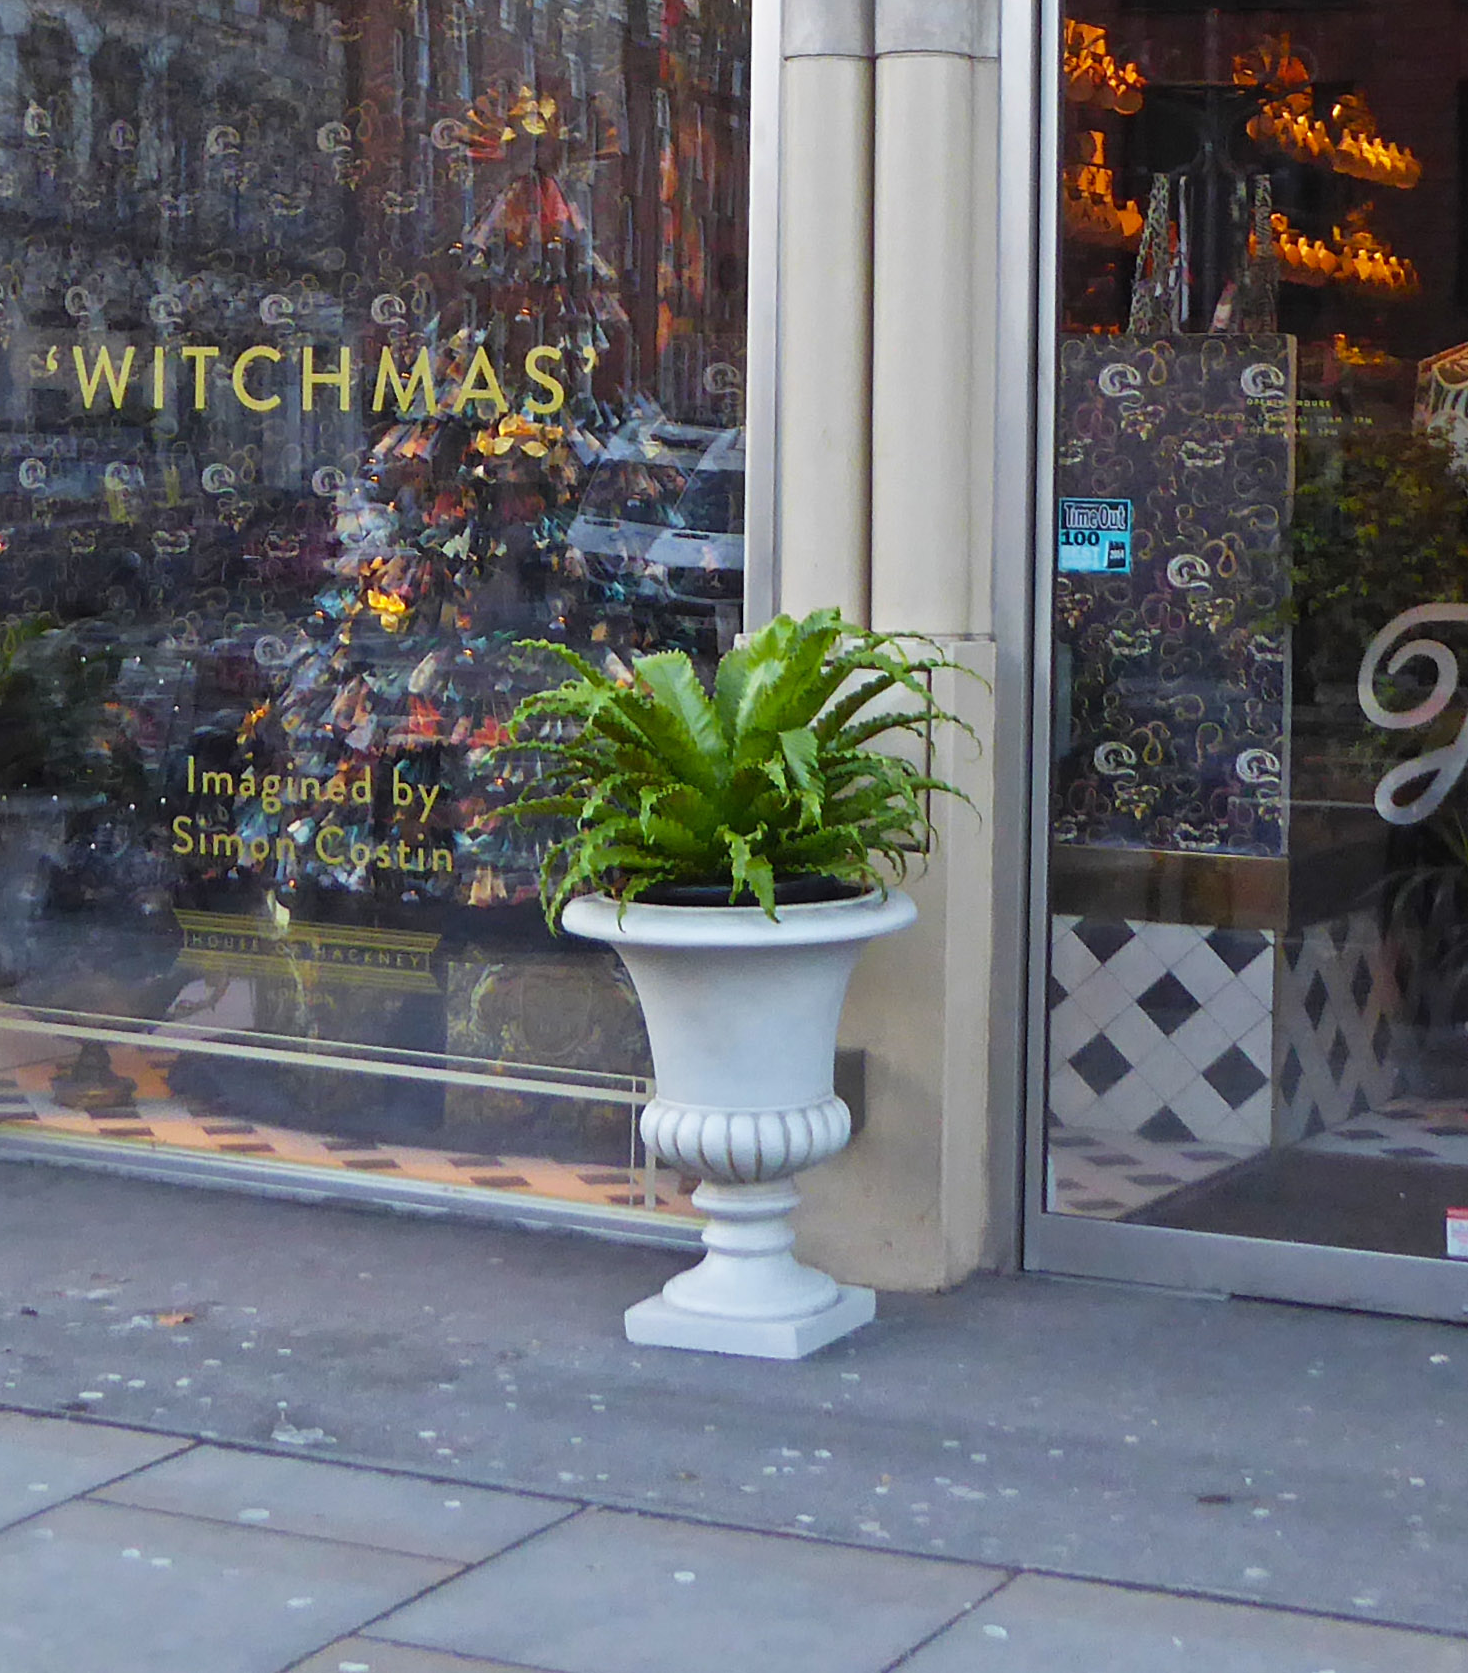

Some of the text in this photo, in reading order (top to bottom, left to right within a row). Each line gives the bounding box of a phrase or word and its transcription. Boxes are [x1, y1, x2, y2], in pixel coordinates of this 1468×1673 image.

[1060, 530, 1101, 546] 100
[186, 755, 441, 824] Imagined by
[172, 815, 454, 874] Simon Costin
[192, 933, 261, 953] HOUSE
[313, 945, 421, 968] HACKNEY
